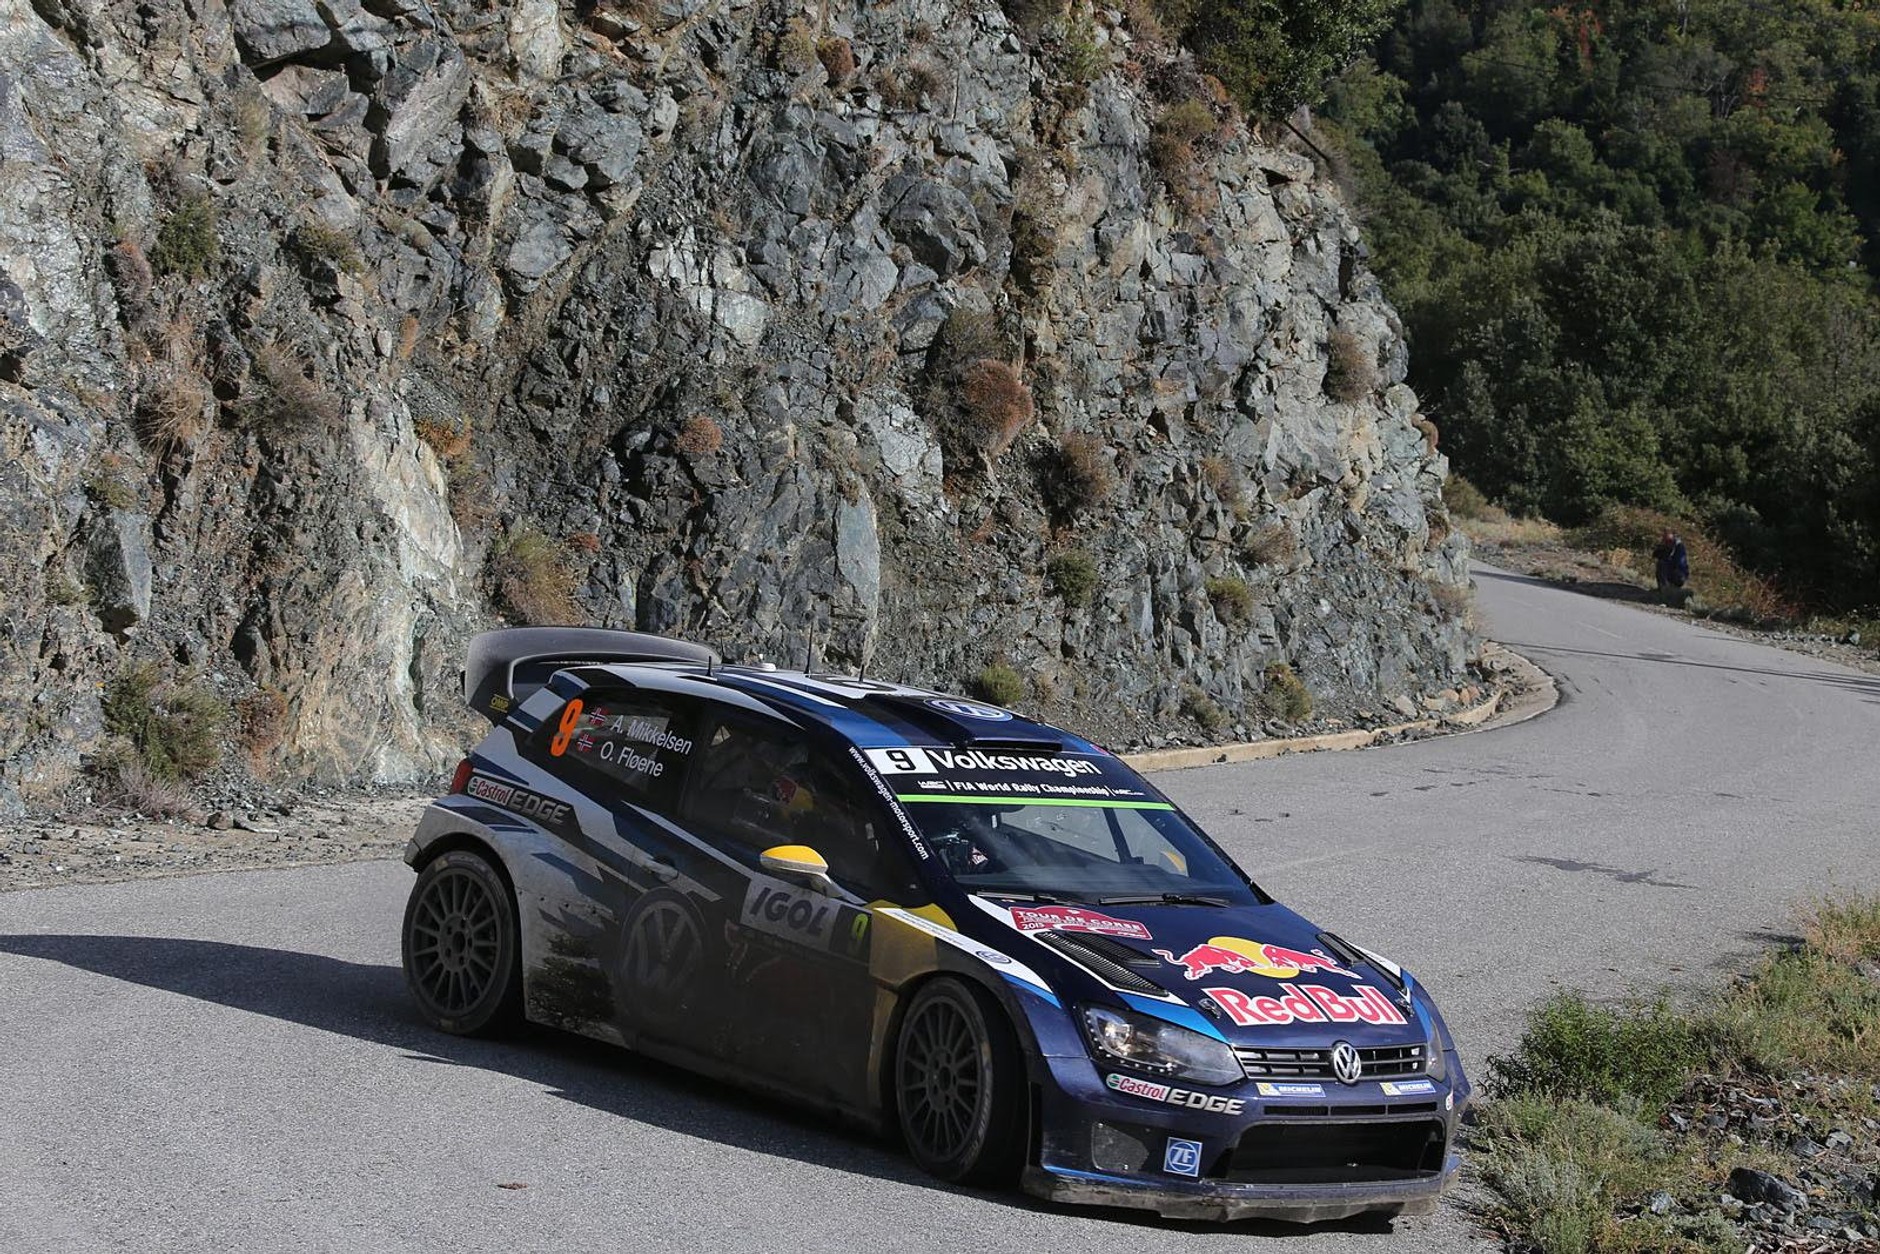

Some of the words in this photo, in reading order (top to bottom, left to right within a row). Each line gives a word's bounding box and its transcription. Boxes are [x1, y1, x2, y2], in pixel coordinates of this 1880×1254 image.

[550, 698, 583, 757] 9
[610, 715, 623, 733] A.
[626, 719, 693, 756] Mikkelsen
[600, 741, 614, 761] O.
[616, 745, 664, 777] Fløene
[883, 750, 917, 771] 9
[925, 749, 1102, 778] Volkswagen
[475, 779, 511, 805] Castrol
[509, 790, 571, 825] EDGE
[849, 746, 929, 861] www.volkswagen-motorsport.com
[953, 781, 977, 791] FIA
[975, 782, 1012, 791] World
[1011, 783, 1041, 794] Rally
[1040, 784, 1109, 797] Championship
[750, 887, 831, 938] IGOL
[1016, 910, 1060, 923] TOUR
[1064, 915, 1085, 925] DE
[1090, 918, 1143, 931] CORSE
[1119, 1077, 1165, 1099] Castrol
[1165, 1088, 1246, 1116] EDGE
[1278, 1085, 1322, 1094] MICHELIN
[1398, 1082, 1435, 1091] MICHELIN
[1170, 1146, 1196, 1167] ZF
